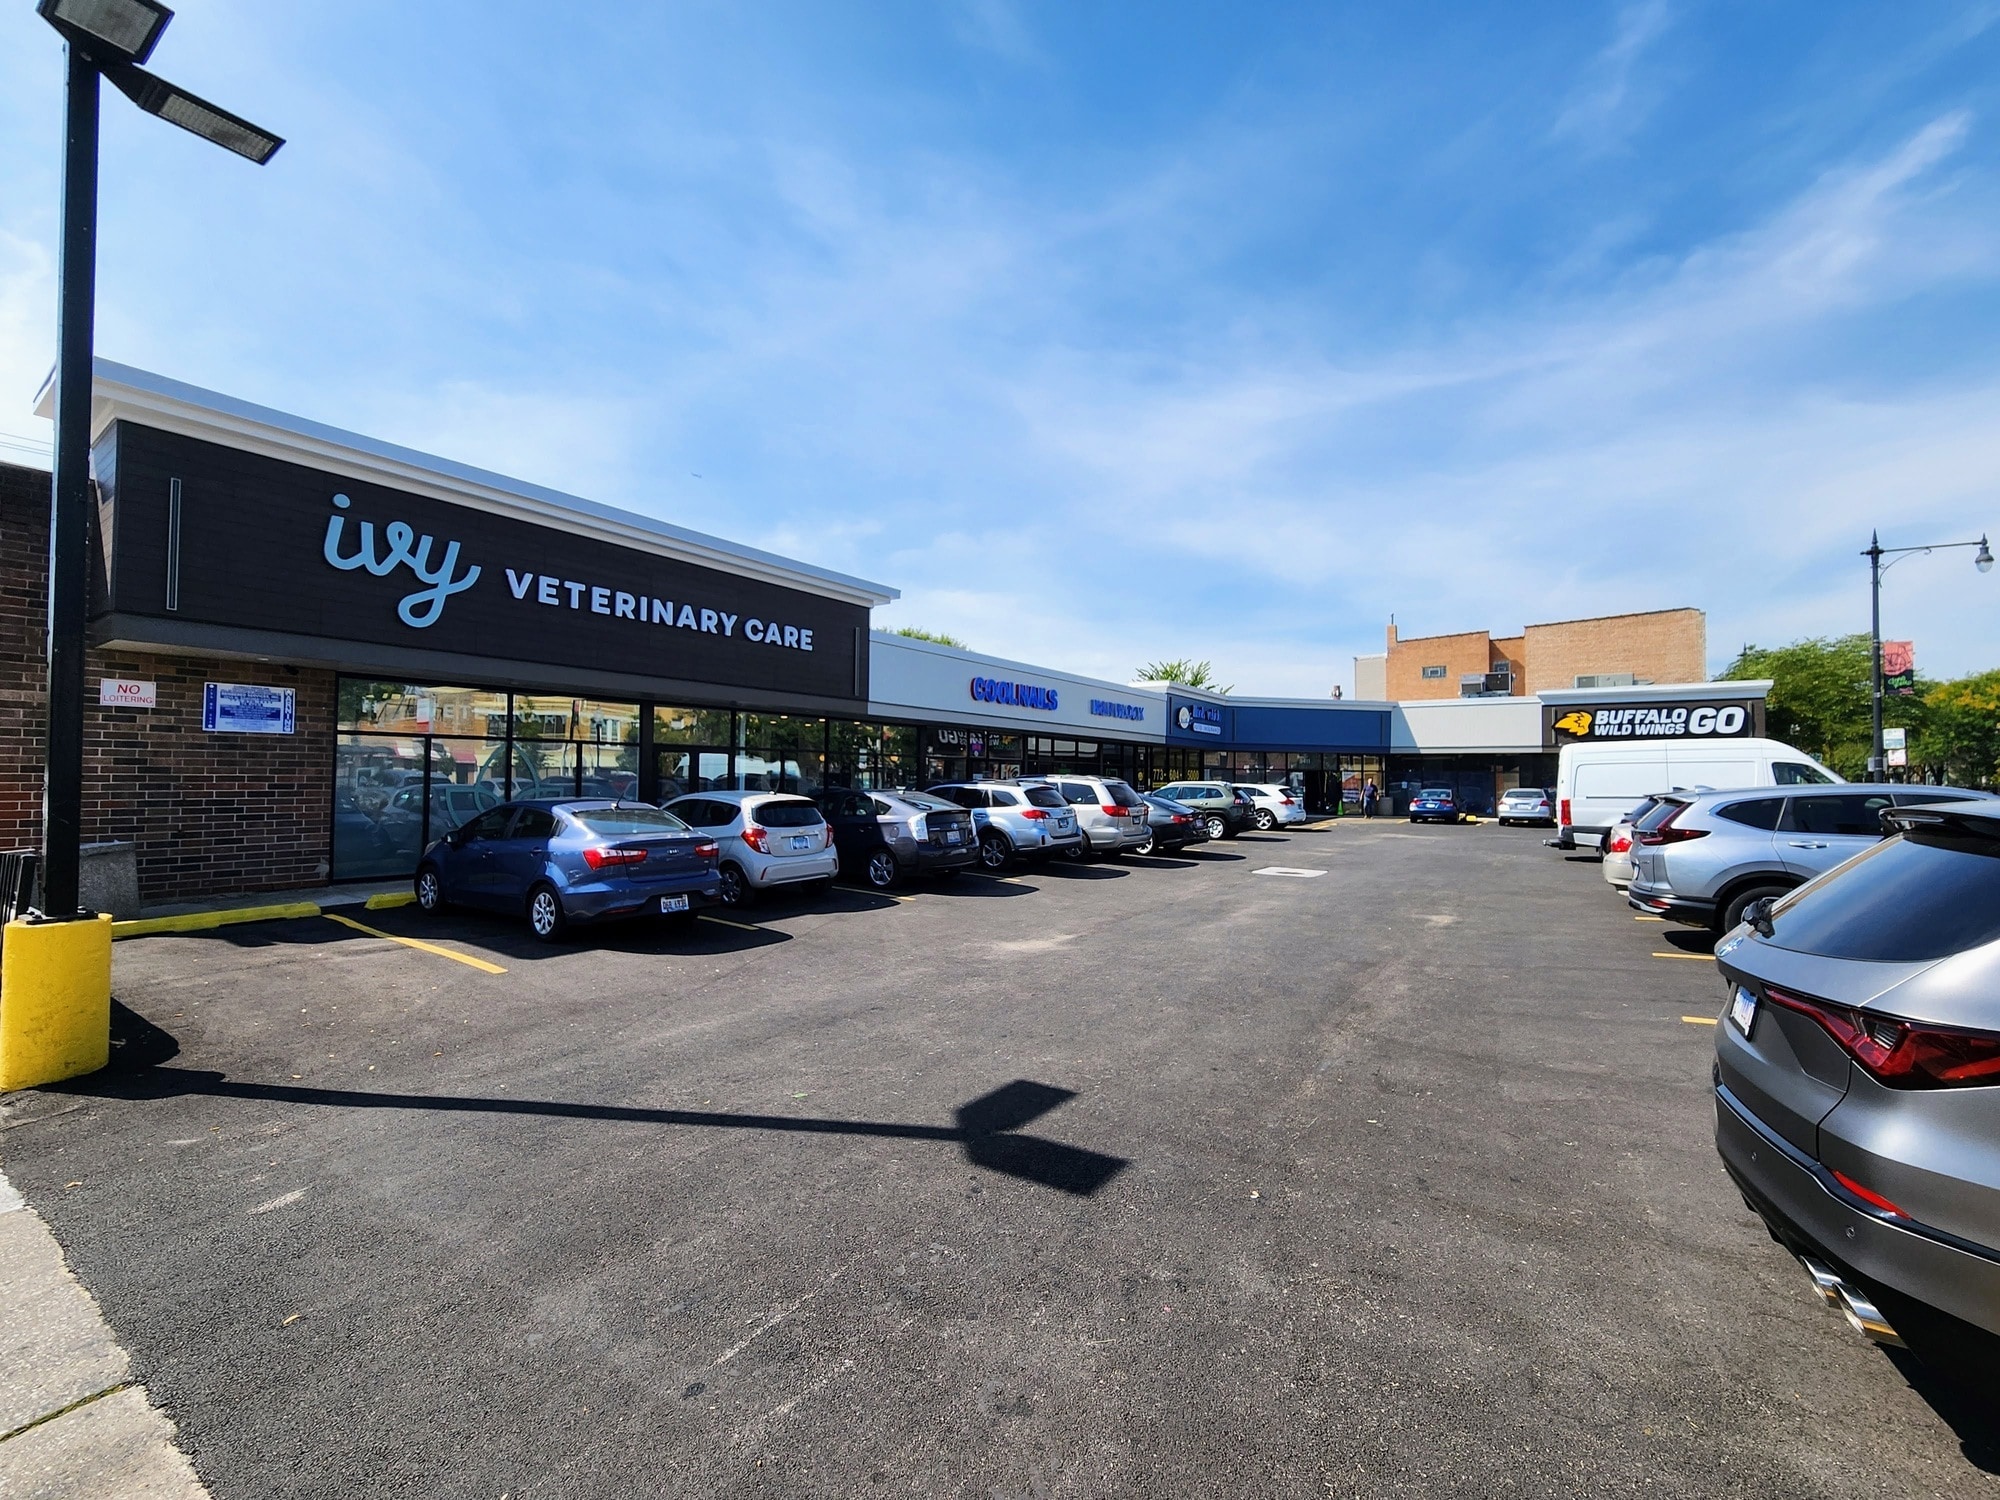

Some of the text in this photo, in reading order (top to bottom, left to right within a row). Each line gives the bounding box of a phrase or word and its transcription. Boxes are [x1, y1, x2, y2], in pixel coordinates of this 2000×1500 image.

[323, 493, 481, 629] ivy
[505, 568, 814, 652] VETERINARY CARE
[103, 694, 153, 704] LOITERING
[117, 683, 140, 695] NO
[971, 677, 1017, 706] COOL
[1594, 723, 1685, 736] WILD WINGS
[1595, 706, 1745, 735] BUFFALO GO
